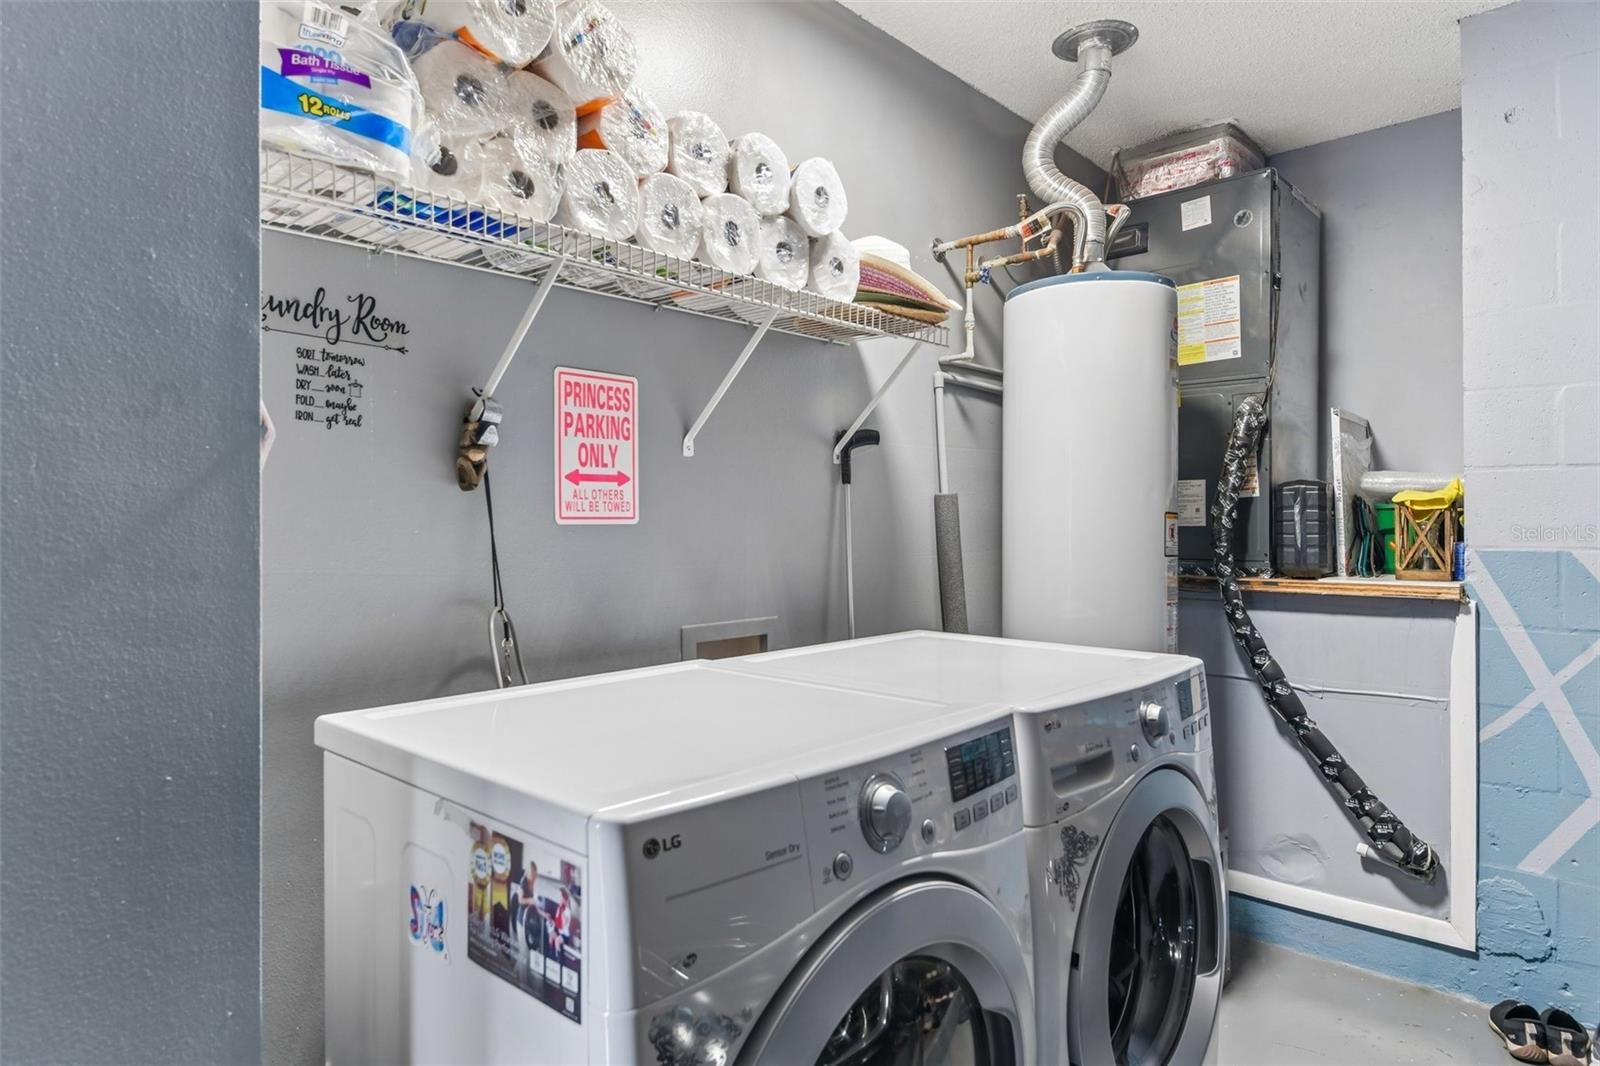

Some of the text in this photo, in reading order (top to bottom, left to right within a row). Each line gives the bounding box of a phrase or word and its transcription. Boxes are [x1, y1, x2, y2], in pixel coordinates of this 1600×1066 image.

[291, 53, 320, 66] Bath
[297, 93, 352, 121] 12 ROLLS
[347, 293, 410, 342] Room
[564, 380, 630, 412] PRINCESS
[564, 411, 631, 441] PARKING
[578, 442, 618, 468] ONLY
[572, 489, 625, 501] ALL OTHERS
[565, 500, 631, 513] WILL BE TOWED
[662, 834, 682, 852] LG
[765, 843, 800, 861] Sensor Dry
